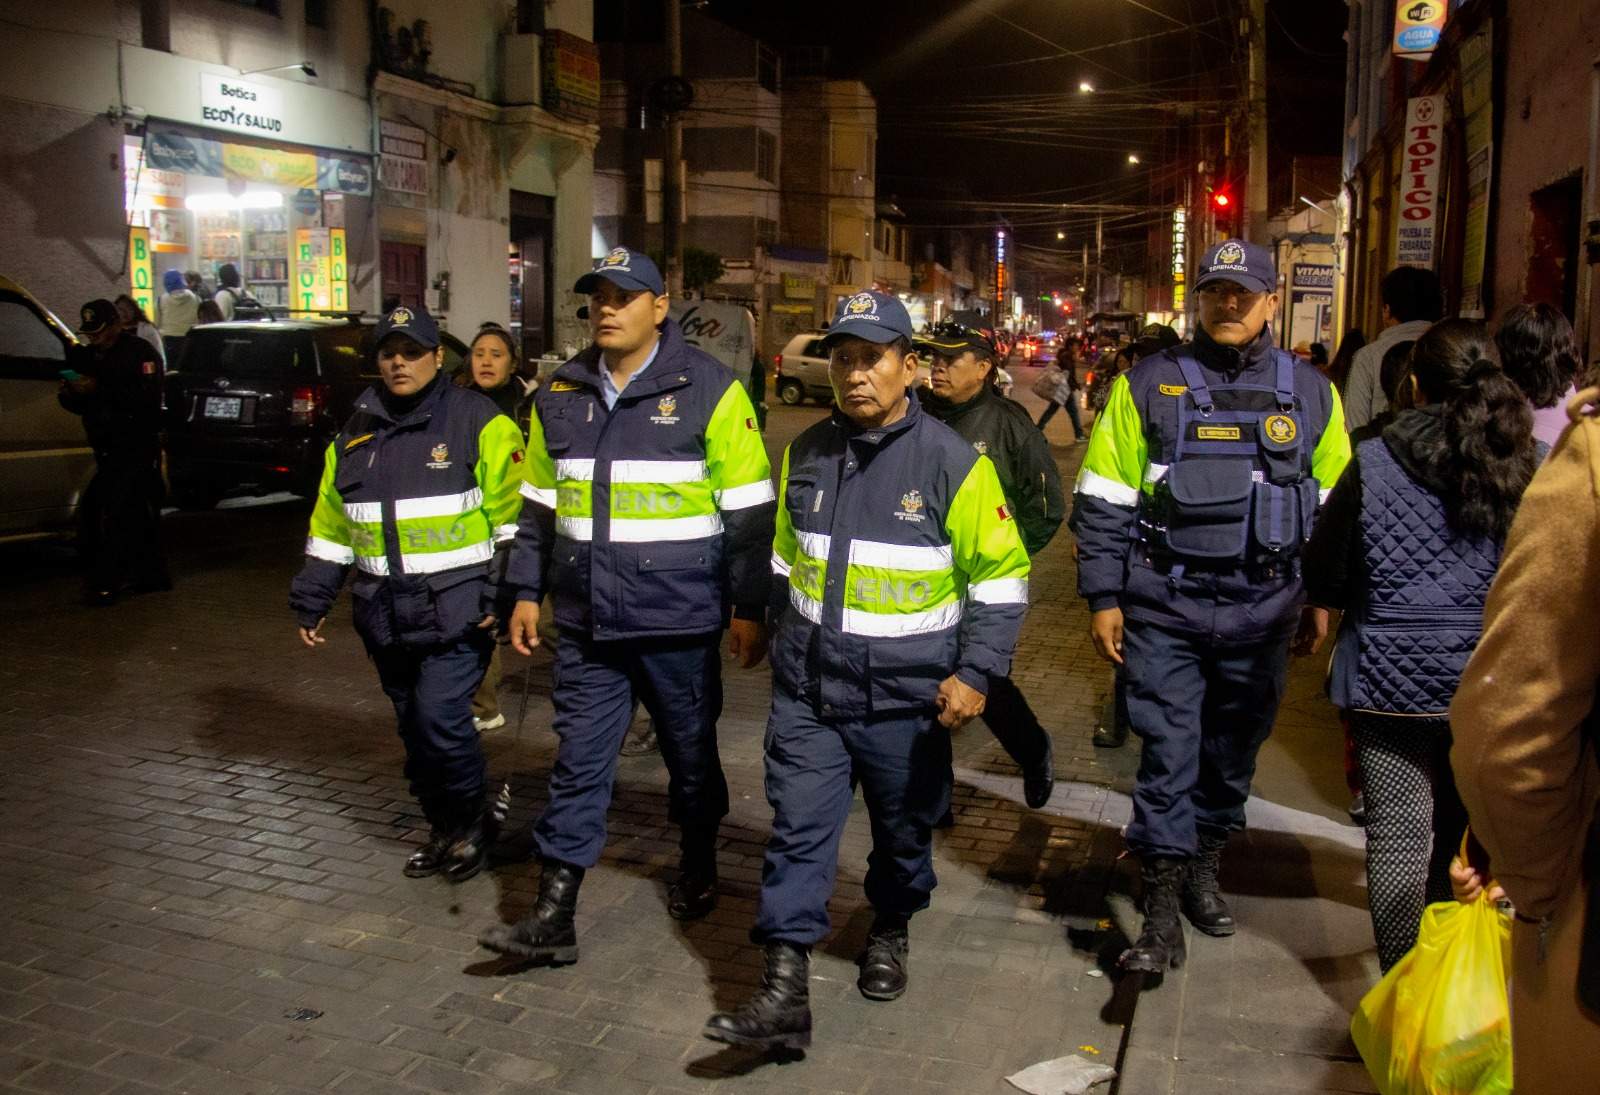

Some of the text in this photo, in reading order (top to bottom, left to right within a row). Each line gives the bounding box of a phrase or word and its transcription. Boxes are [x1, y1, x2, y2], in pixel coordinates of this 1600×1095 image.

[1404, 29, 1434, 41] AGUA
[220, 83, 257, 102] Botica
[245, 115, 282, 133] SALUD
[1402, 124, 1438, 221] TOPICO
[1423, 227, 1432, 238] DE
